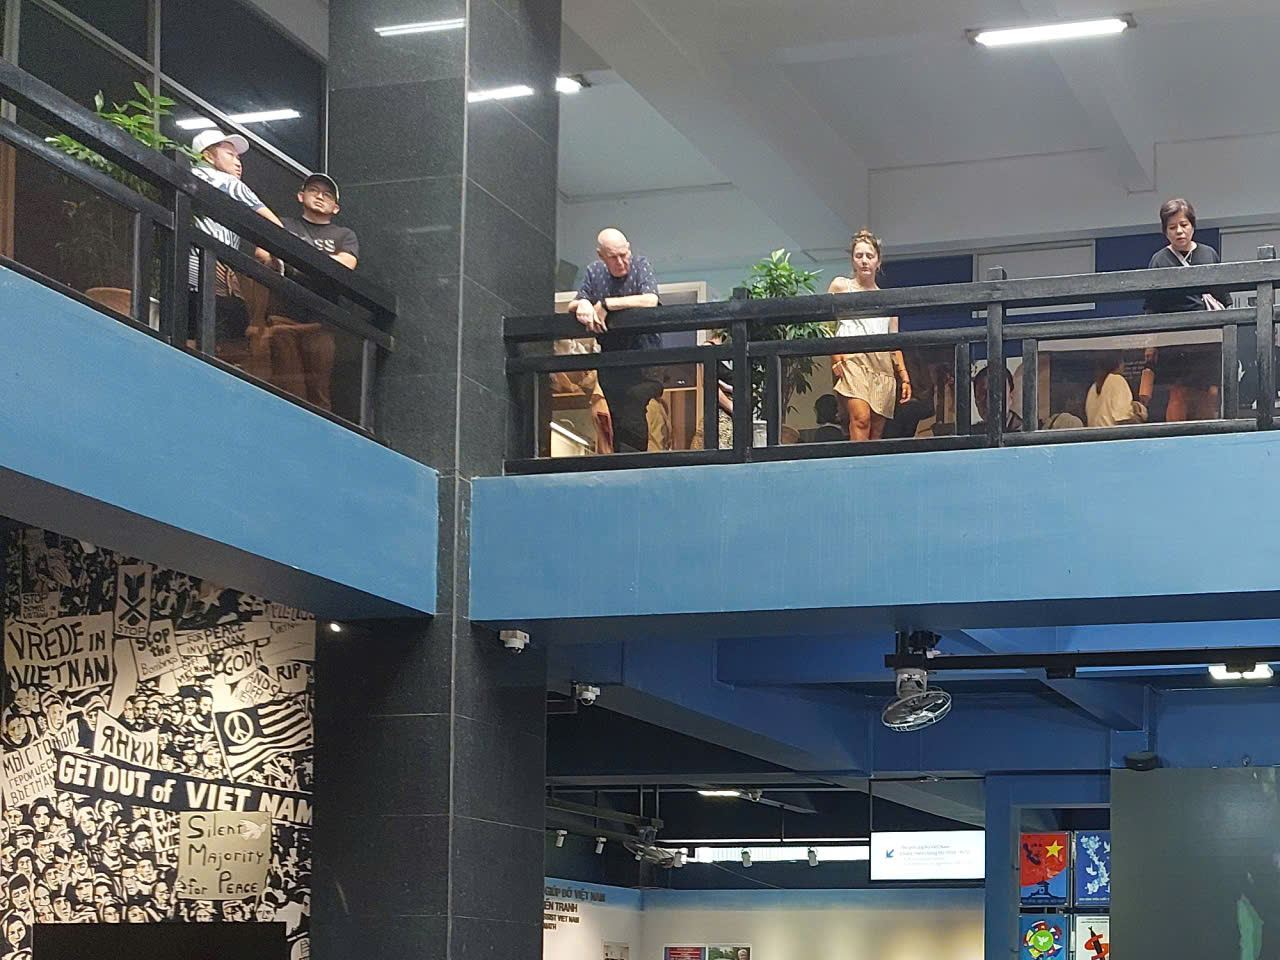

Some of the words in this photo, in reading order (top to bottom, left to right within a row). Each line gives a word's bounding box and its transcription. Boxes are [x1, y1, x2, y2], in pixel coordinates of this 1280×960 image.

[7, 621, 84, 661] VREDE
[89, 630, 106, 652] IN
[116, 623, 147, 636] STOP
[102, 725, 154, 767] ЯНКИ
[58, 754, 101, 788] GET
[102, 765, 151, 799] OUT
[151, 778, 177, 804] of
[185, 780, 252, 813] VIET
[258, 791, 313, 826] NAM
[187, 878, 208, 896] for
[555, 901, 578, 913] TRANH
